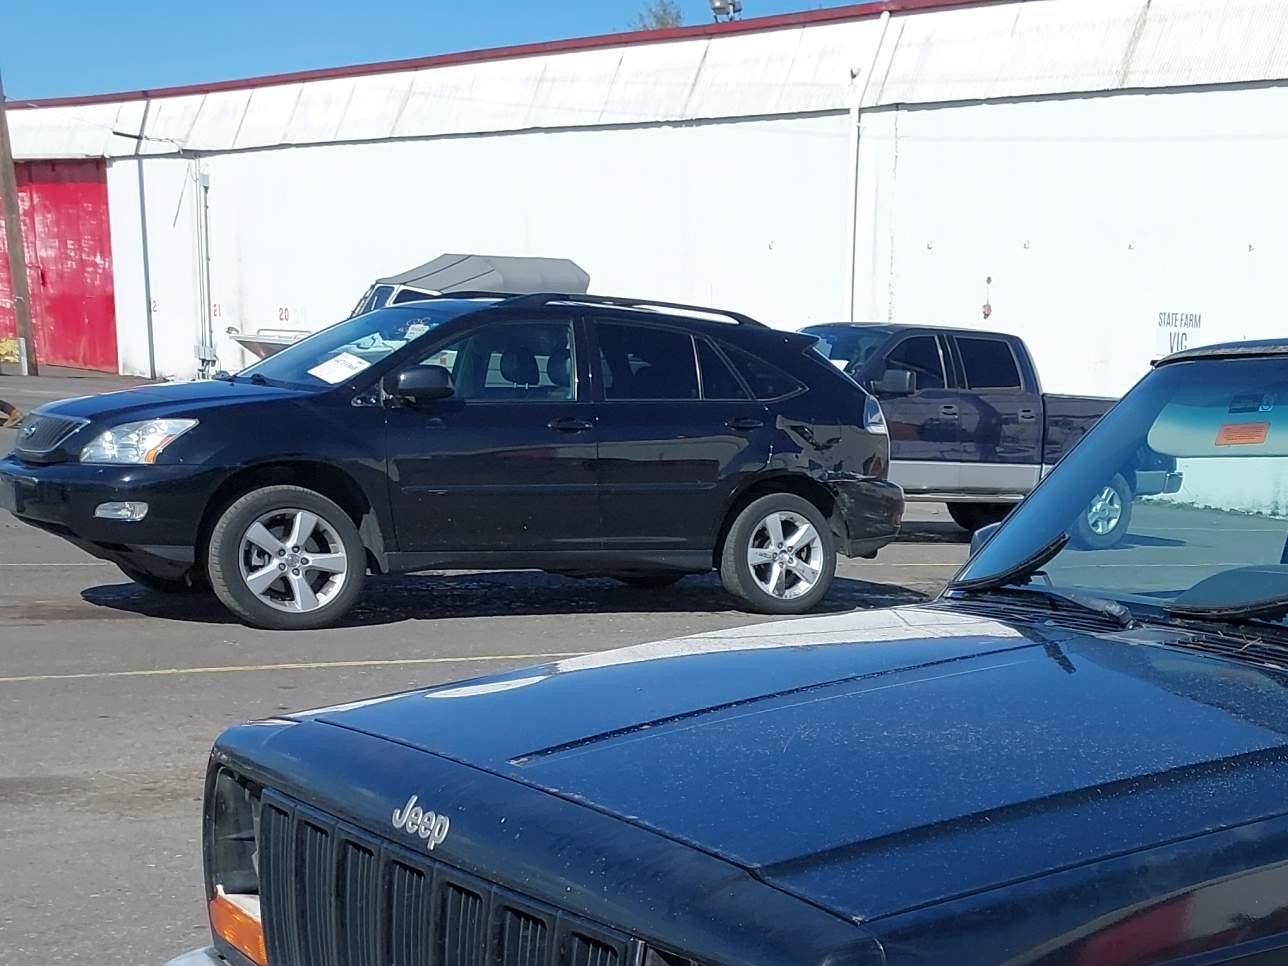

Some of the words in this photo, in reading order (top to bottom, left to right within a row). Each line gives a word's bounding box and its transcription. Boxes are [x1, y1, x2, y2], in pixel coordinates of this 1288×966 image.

[279, 307, 289, 320] 20
[1158, 312, 1179, 327] STATE
[1180, 312, 1201, 328] FARM
[392, 795, 450, 850] Jeep
